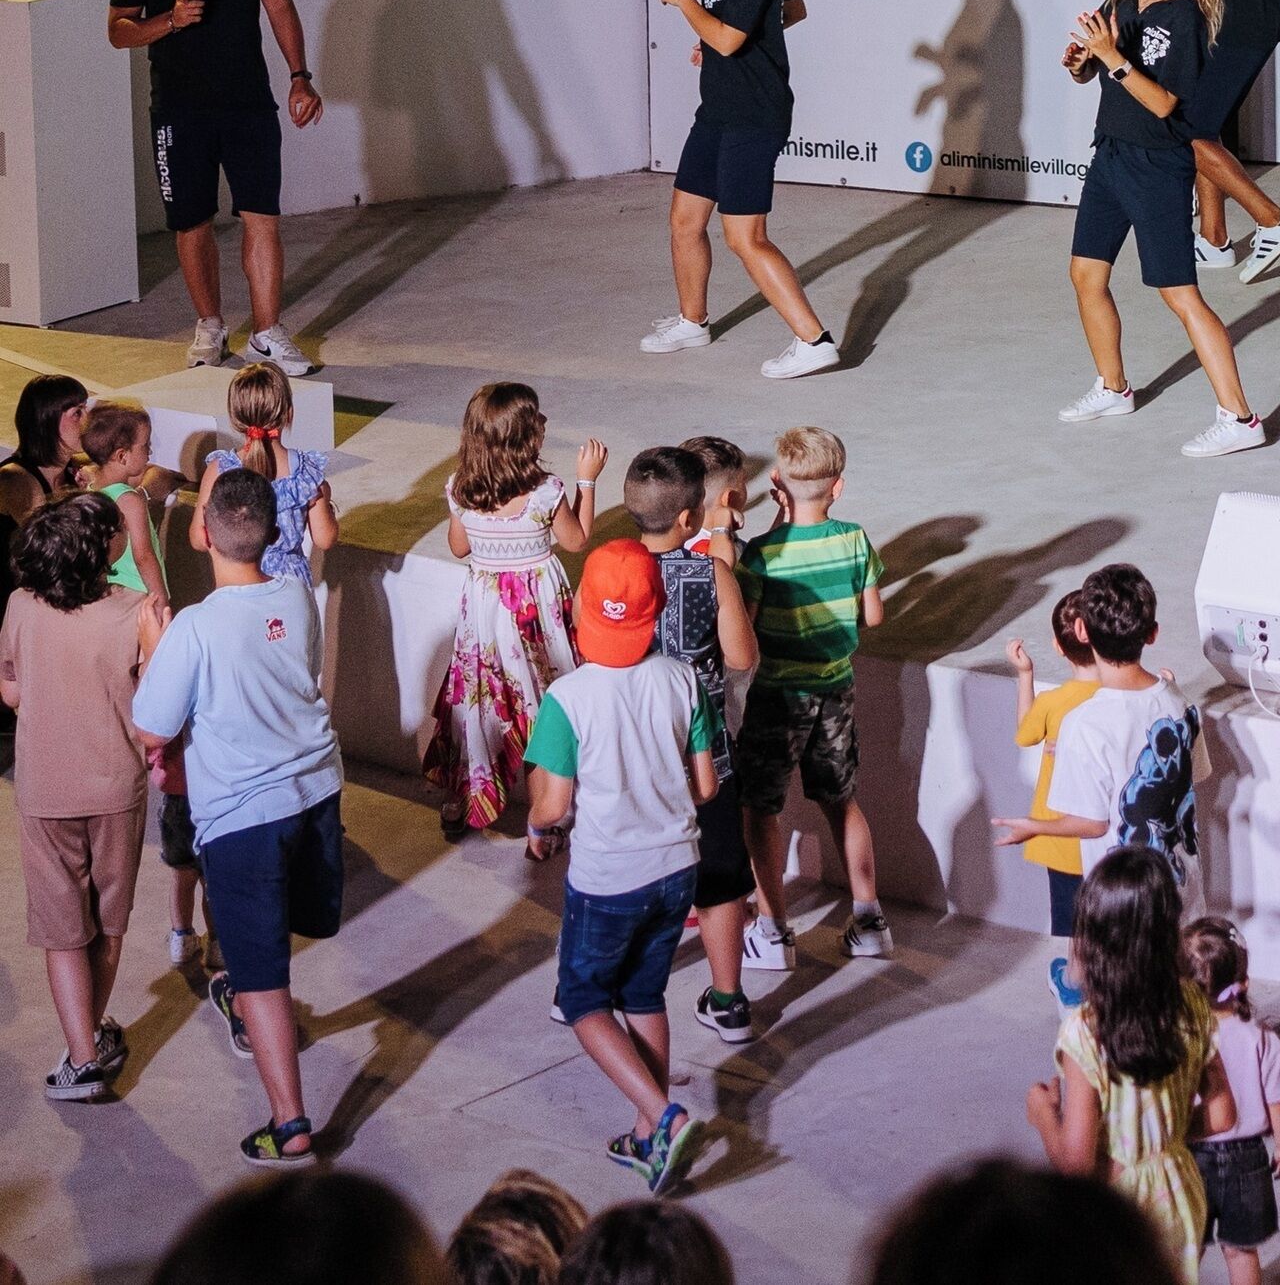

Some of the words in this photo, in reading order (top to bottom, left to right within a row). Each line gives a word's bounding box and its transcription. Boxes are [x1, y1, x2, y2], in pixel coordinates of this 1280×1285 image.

[780, 139, 878, 163] nismile.it
[940, 151, 1088, 181] aliminismilevillag
[265, 630, 287, 642] VANS
